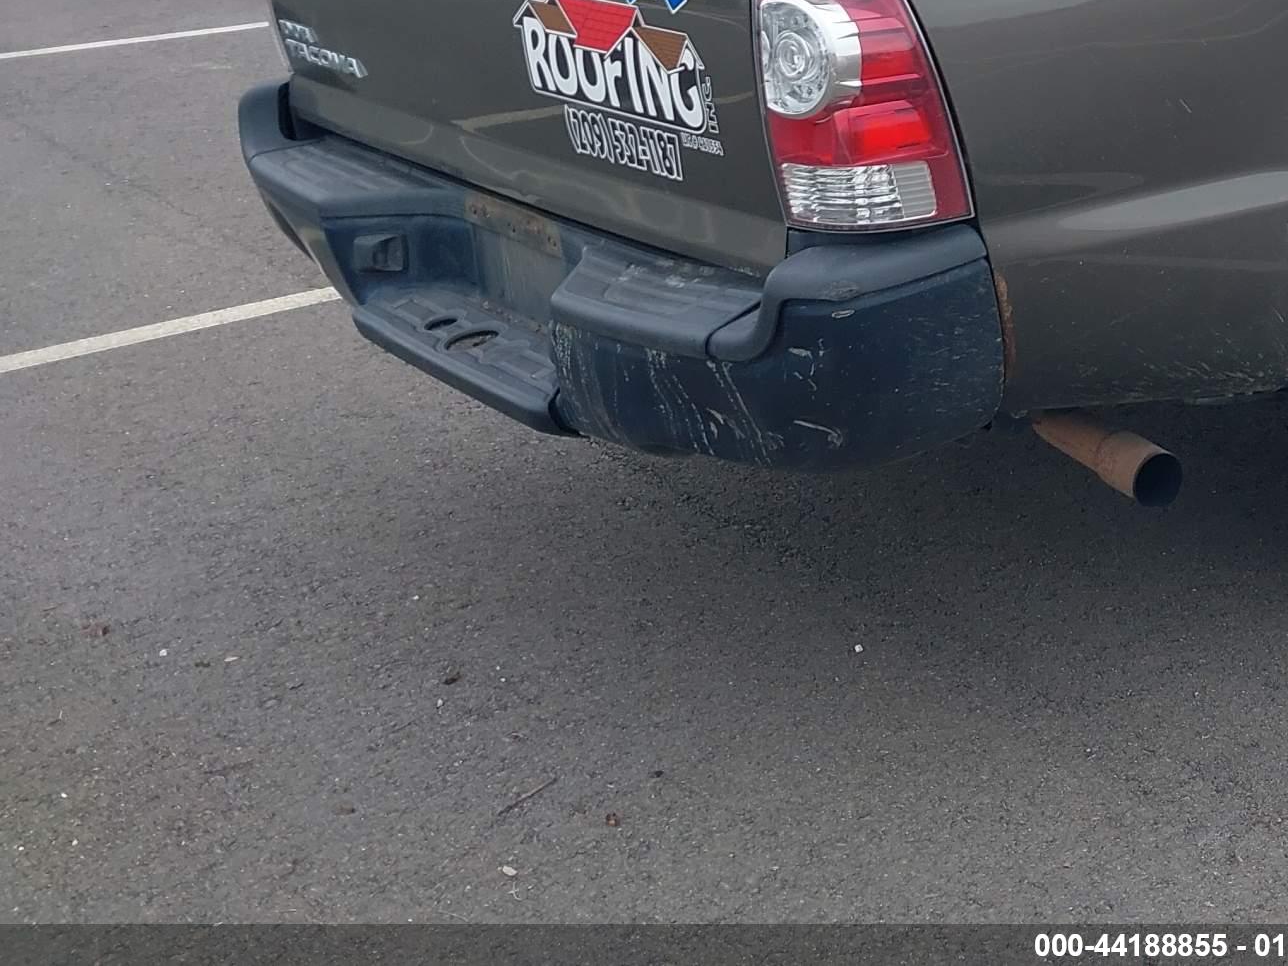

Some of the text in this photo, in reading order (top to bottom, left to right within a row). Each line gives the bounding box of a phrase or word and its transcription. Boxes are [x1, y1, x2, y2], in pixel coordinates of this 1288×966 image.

[284, 37, 369, 79] TACOMA
[521, 15, 703, 129] ROOFING
[564, 103, 684, 181] (209) 532-1187
